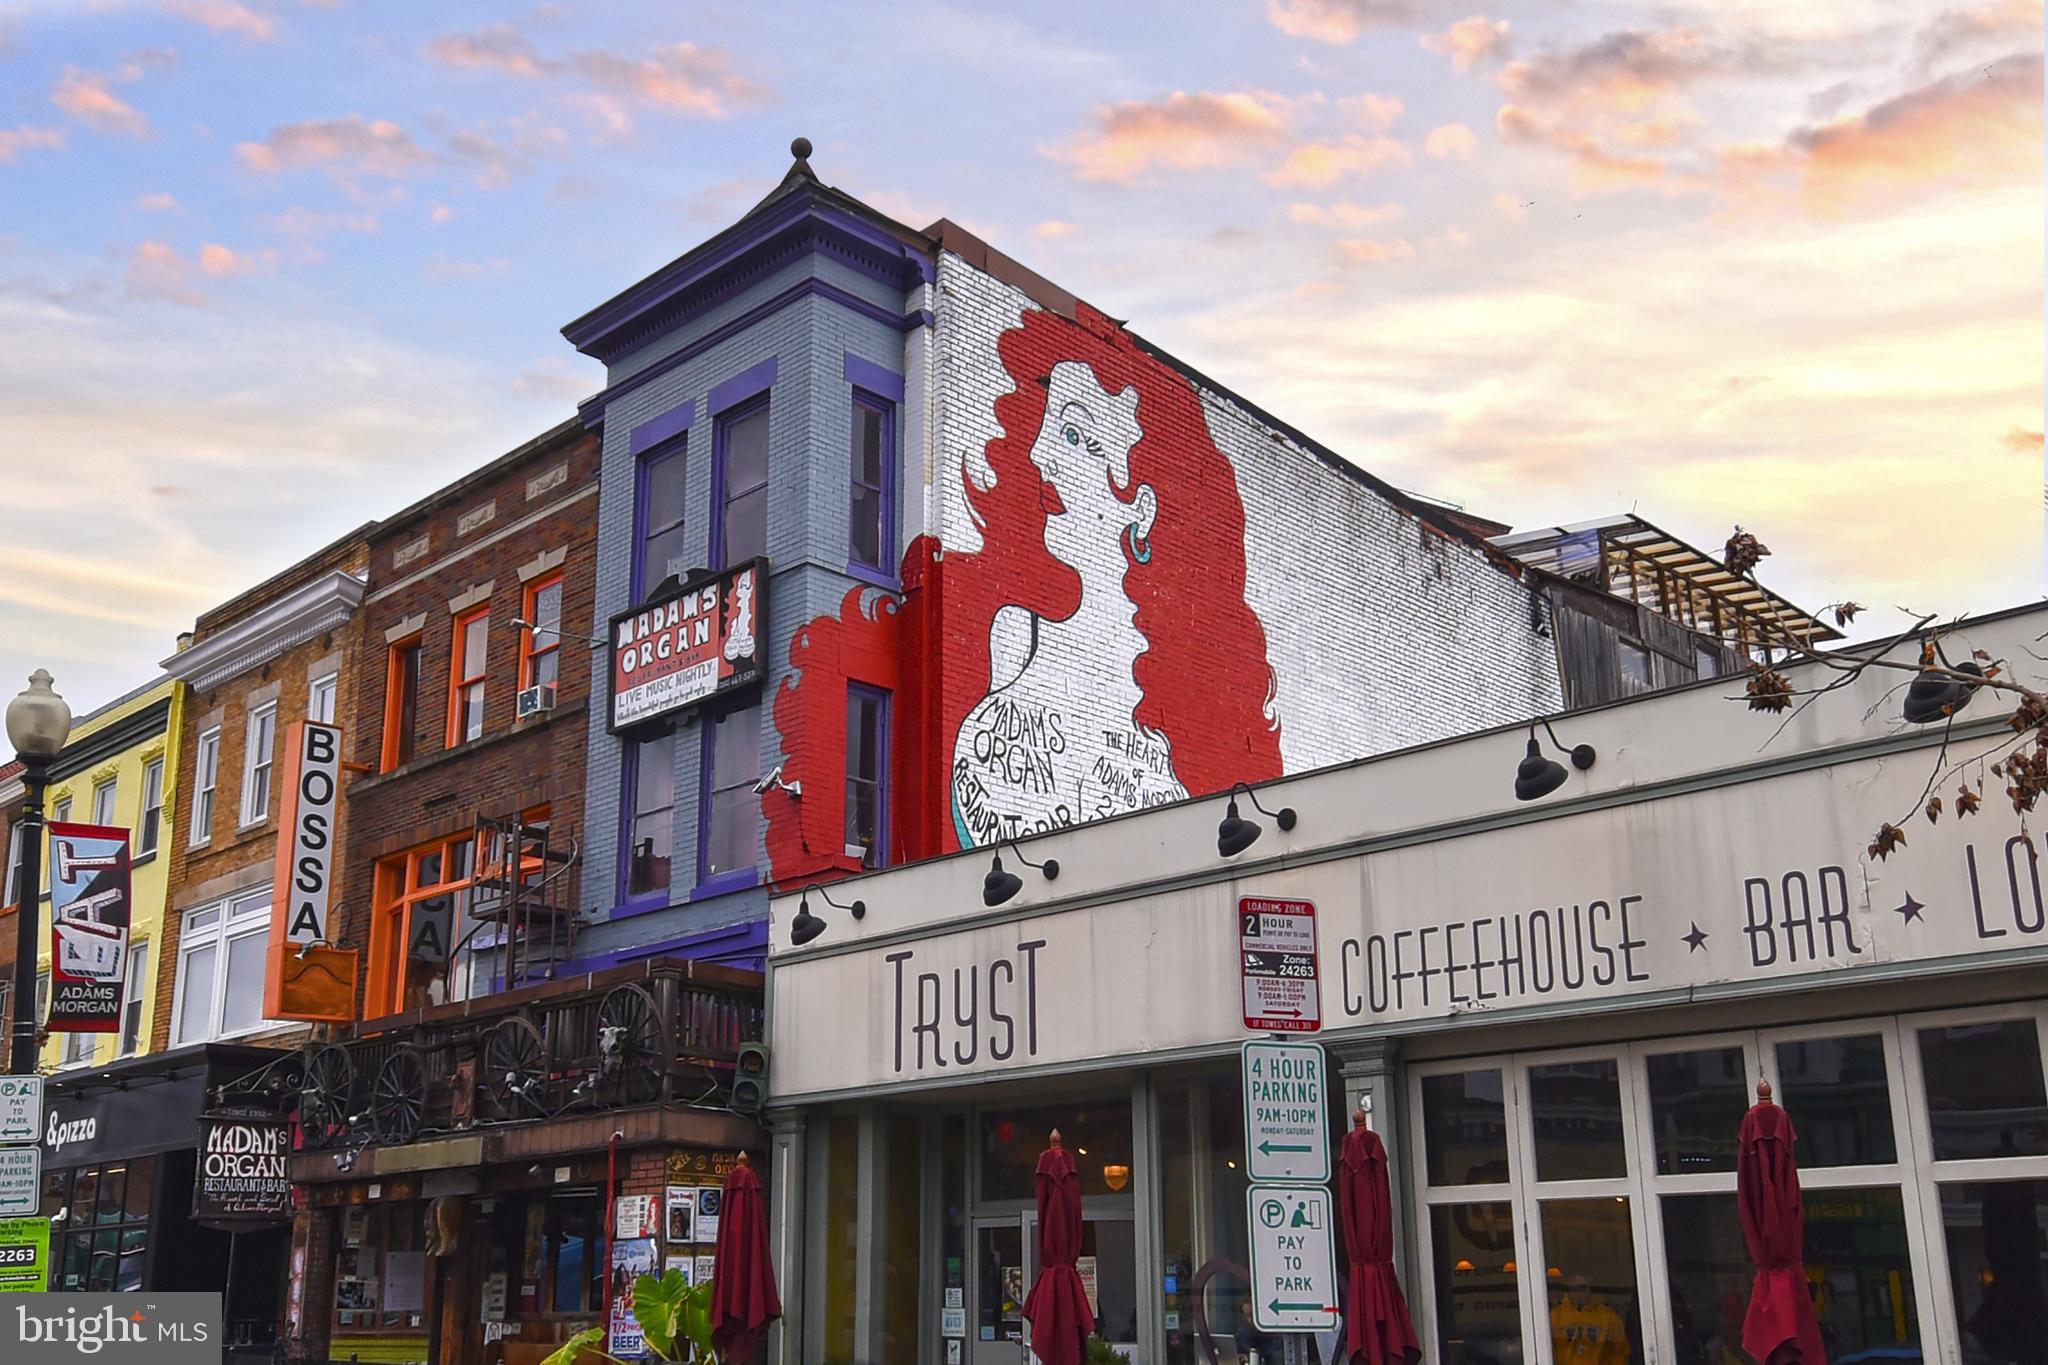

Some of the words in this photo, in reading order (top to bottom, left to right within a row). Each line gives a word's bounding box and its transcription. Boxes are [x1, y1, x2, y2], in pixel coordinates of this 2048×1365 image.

[617, 584, 717, 649] MADAM'S
[621, 616, 710, 674] ORGAN
[618, 688, 642, 708] LIVE
[645, 676, 673, 698] MUSIC
[976, 697, 1065, 754] MADAM'S
[974, 729, 1057, 794] ORGAN
[1102, 731, 1124, 749] THE
[1126, 732, 1169, 775] HEART
[1092, 755, 1137, 808] ADAMS
[1132, 768, 1145, 786] OF
[288, 727, 336, 939] BOSSA
[56, 840, 125, 981] EAT
[1247, 902, 1281, 913] LOADING
[1284, 904, 1306, 914] ZONE
[1246, 915, 1256, 934] 2
[1263, 918, 1293, 928] HOUR
[1341, 895, 1650, 1016] COFFEEHOUSE
[1743, 865, 1862, 966] BAR
[1966, 833, 2048, 939] LO
[1245, 942, 1275, 950] COMMERCIAL
[1283, 955, 1311, 964] Zone:
[1279, 965, 1314, 976] 24263
[60, 987, 114, 1000] ADAMS
[53, 1001, 118, 1014] MORGAN
[885, 940, 1047, 1073] TRYST
[1284, 1021, 1299, 1029] CALL
[1252, 1058, 1262, 1078] 4
[1271, 1058, 1315, 1080] HOUR
[1253, 1081, 1317, 1103] PARKING
[1257, 1108, 1316, 1123] 9AM-10PM
[47, 1110, 96, 1152] &pizza
[207, 1125, 287, 1154] MADAM'S
[1261, 1127, 1314, 1135] MONDAY-SATURDAY
[8, 1155, 32, 1164] HOUR
[205, 1154, 286, 1178] ORGAN
[1278, 1236, 1304, 1250] PAY
[1284, 1256, 1302, 1270] TO
[1275, 1277, 1313, 1291] PARK
[613, 1335, 640, 1348] BEER
